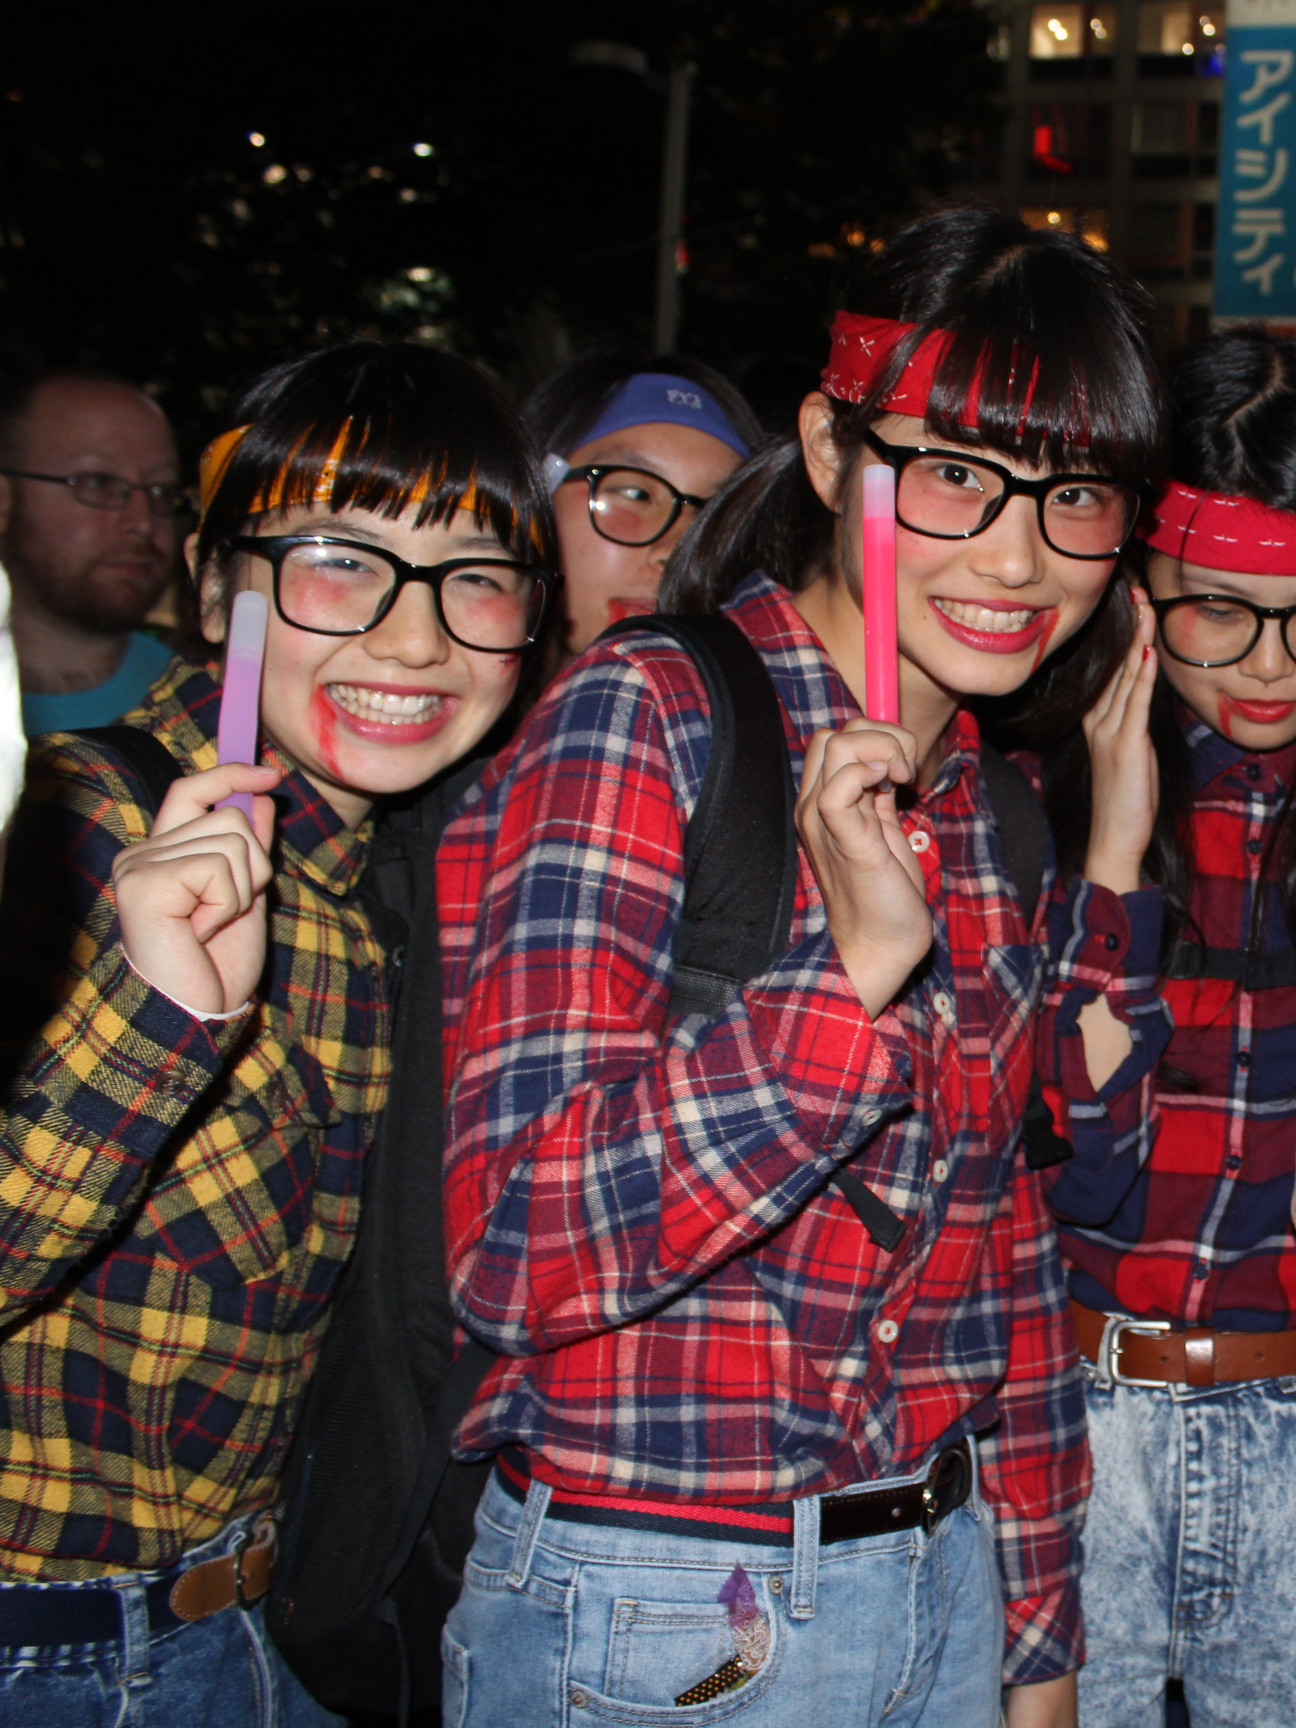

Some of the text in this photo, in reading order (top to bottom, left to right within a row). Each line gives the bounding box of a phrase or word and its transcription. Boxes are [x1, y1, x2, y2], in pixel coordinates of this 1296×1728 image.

[1233, 49, 1294, 295] アイシティ
